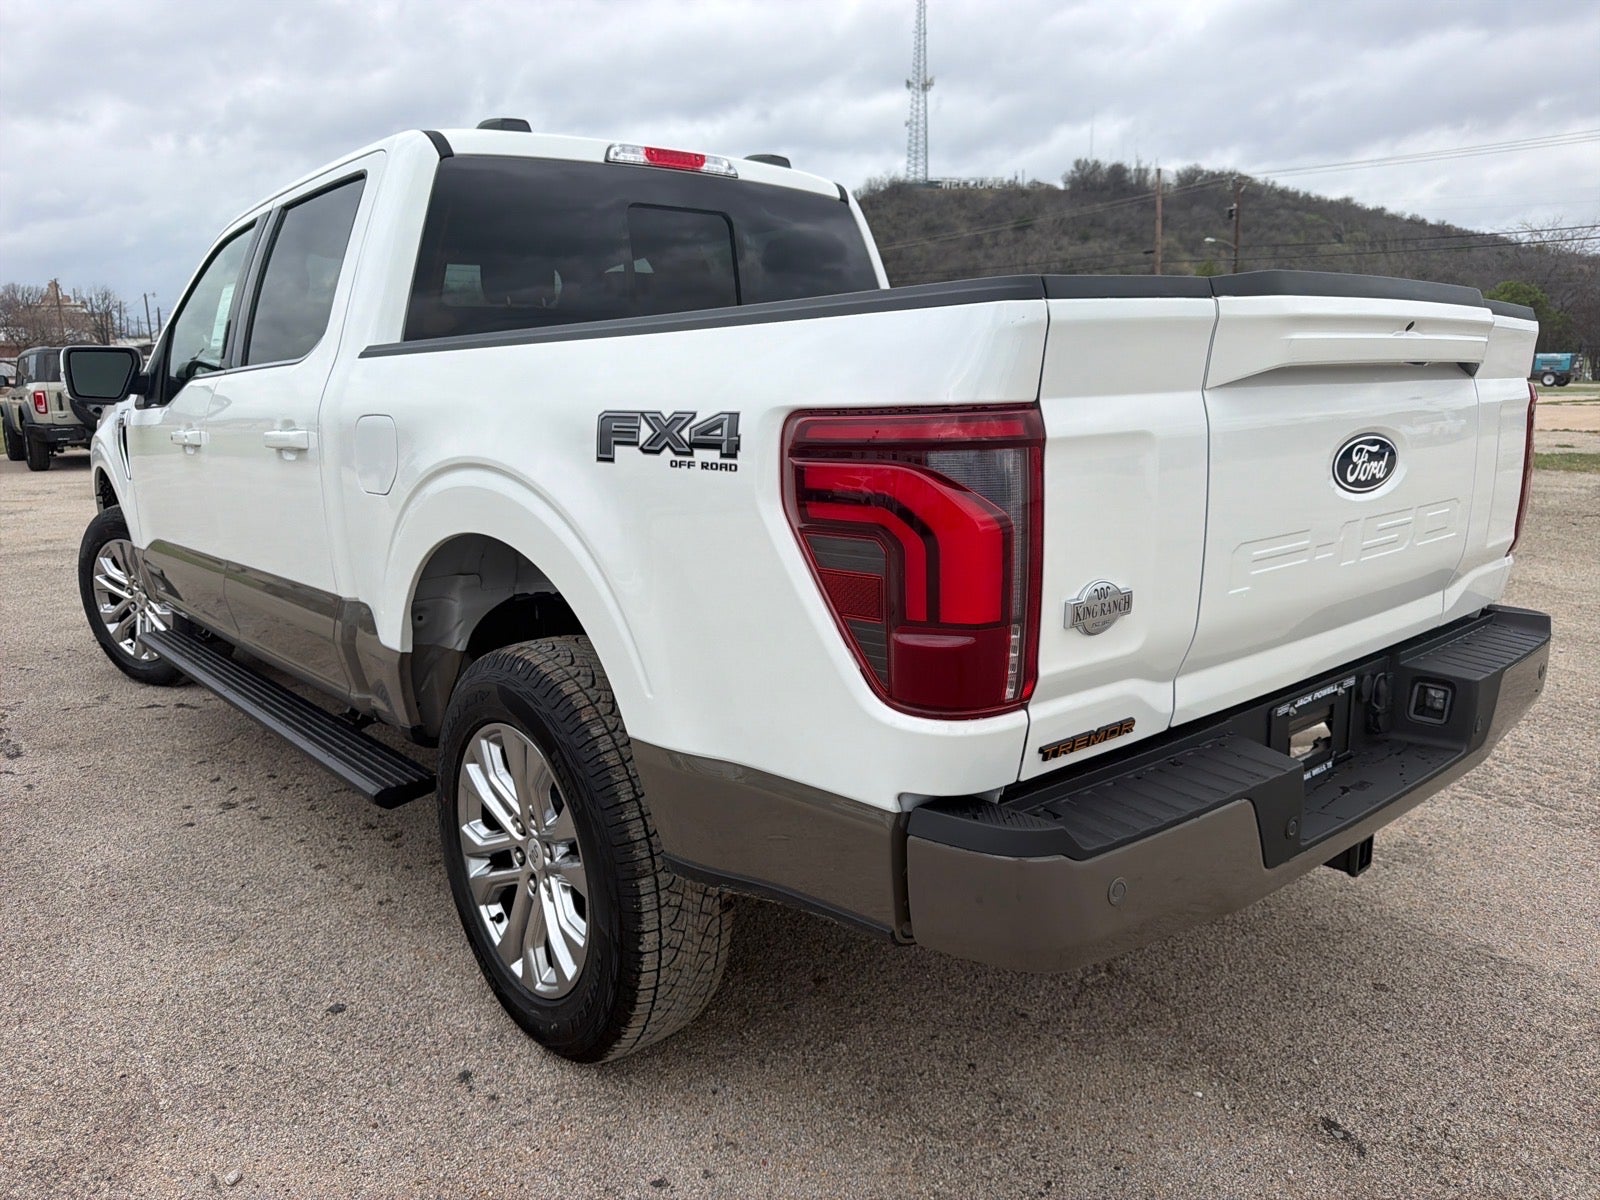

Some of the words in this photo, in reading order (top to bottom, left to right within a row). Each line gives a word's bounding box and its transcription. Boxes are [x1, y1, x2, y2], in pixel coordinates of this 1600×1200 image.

[596, 410, 741, 463] FX4
[669, 459, 696, 470] OFF
[701, 461, 738, 473] ROAD
[1346, 444, 1388, 483] Ford
[1228, 497, 1462, 594] F-150
[1075, 603, 1099, 622] KING
[1100, 594, 1131, 616] RANCH
[1295, 694, 1312, 708] JACK
[1313, 684, 1338, 700] POWELL
[1038, 716, 1136, 762] TREMOR
